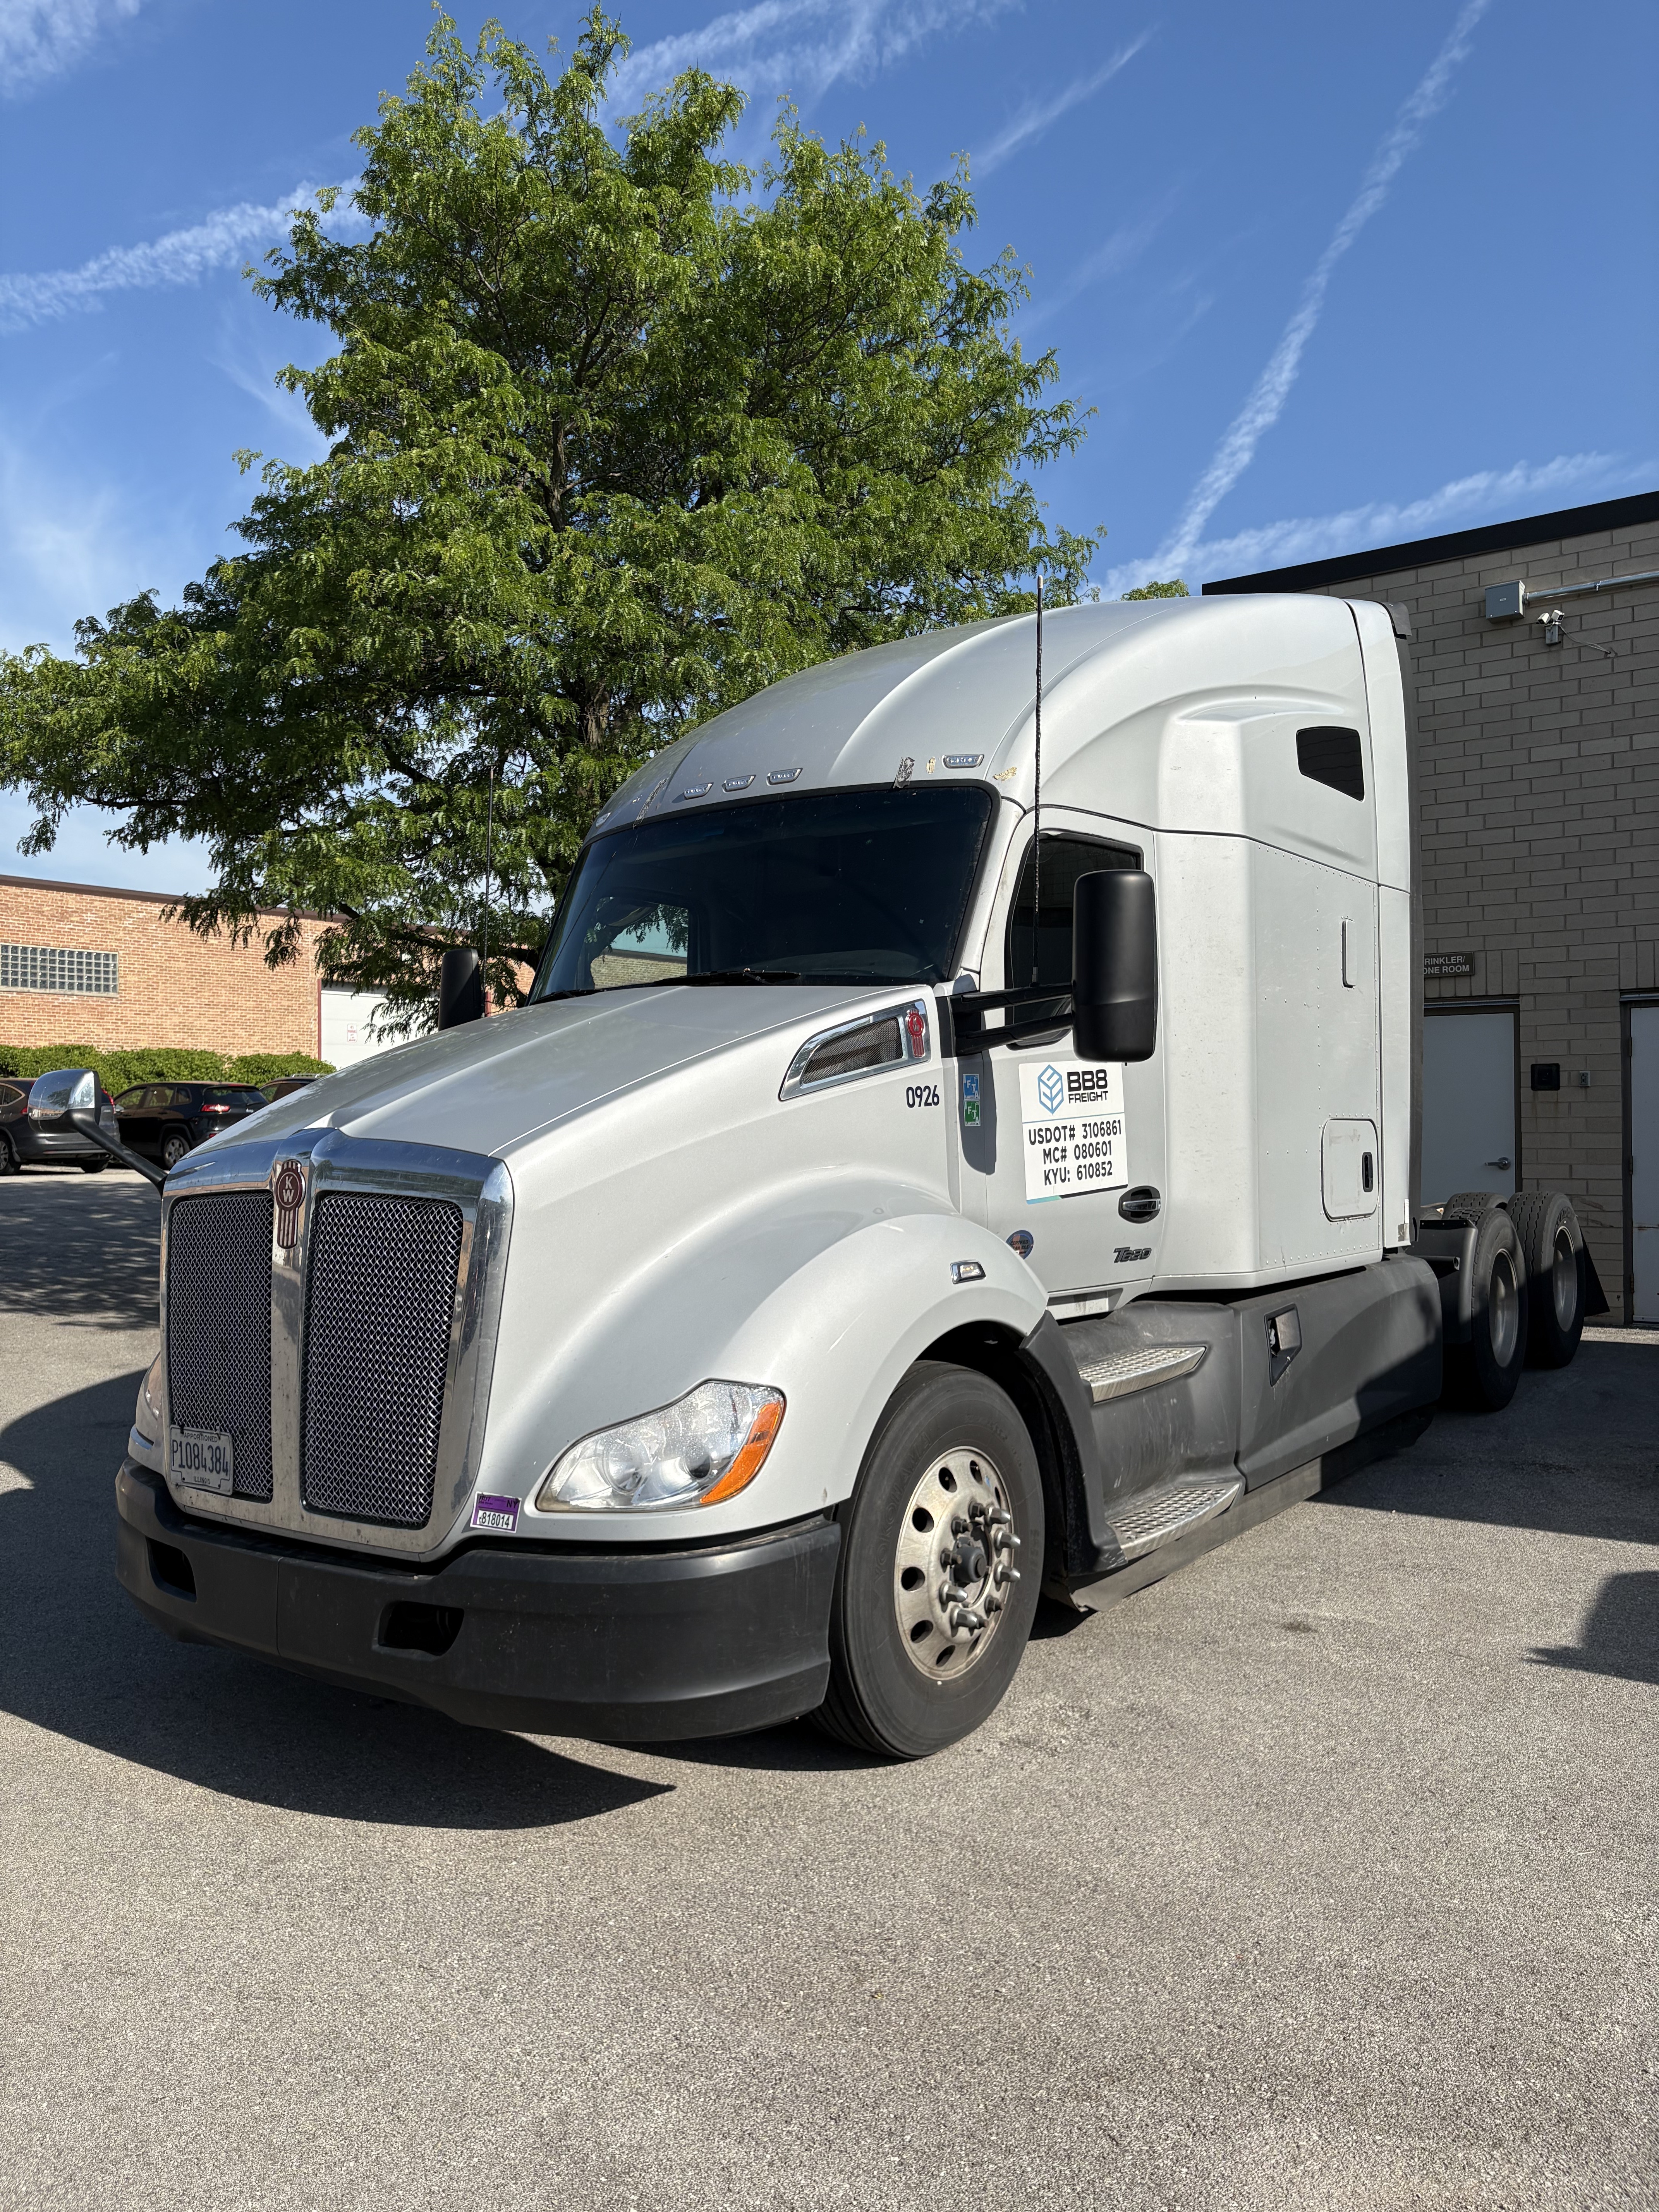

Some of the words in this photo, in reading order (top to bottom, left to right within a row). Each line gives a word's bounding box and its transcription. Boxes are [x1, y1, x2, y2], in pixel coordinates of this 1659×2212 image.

[1424, 956, 1465, 965] RINKLER/
[1424, 966, 1440, 974] ONE
[1442, 964, 1469, 973] ROOM
[1067, 1069, 1108, 1092] BB8
[906, 1085, 939, 1108] 0926
[1068, 1091, 1109, 1104] FREIGHT
[1029, 1125, 1075, 1146] USDOT#
[1082, 1119, 1121, 1139] 3106861
[1043, 1146, 1067, 1164] MC#
[1074, 1140, 1112, 1160] 080601
[1044, 1166, 1070, 1186] KYU:
[1077, 1161, 1113, 1181] 610852
[1113, 1246, 1152, 1264] T680
[184, 1432, 218, 1443] APPORTIONED
[172, 1439, 228, 1476] P1084384
[194, 1476, 210, 1484] ILLINOIS
[507, 1499, 520, 1508] NY
[479, 1511, 510, 1528] 818014
